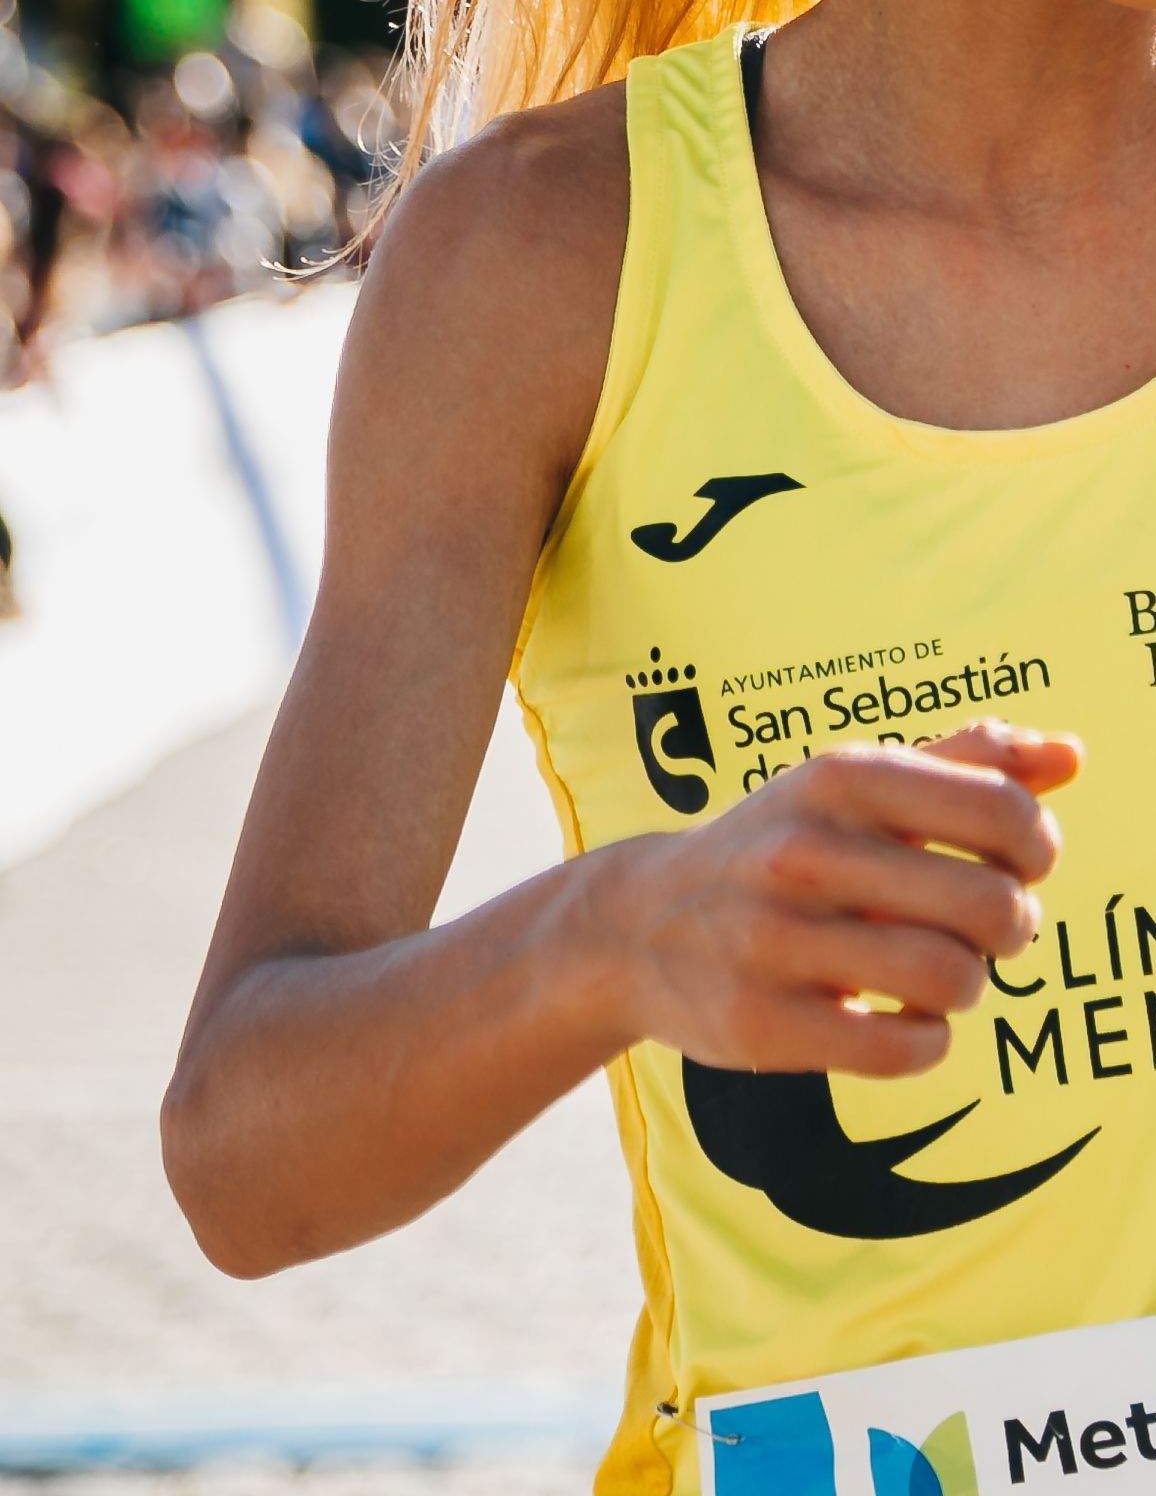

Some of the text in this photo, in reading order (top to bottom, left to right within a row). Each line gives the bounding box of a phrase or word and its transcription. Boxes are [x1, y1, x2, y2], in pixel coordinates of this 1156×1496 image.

[720, 638, 944, 697] AYUNTAMIENTO DE
[727, 652, 1051, 749] San Sebastián
